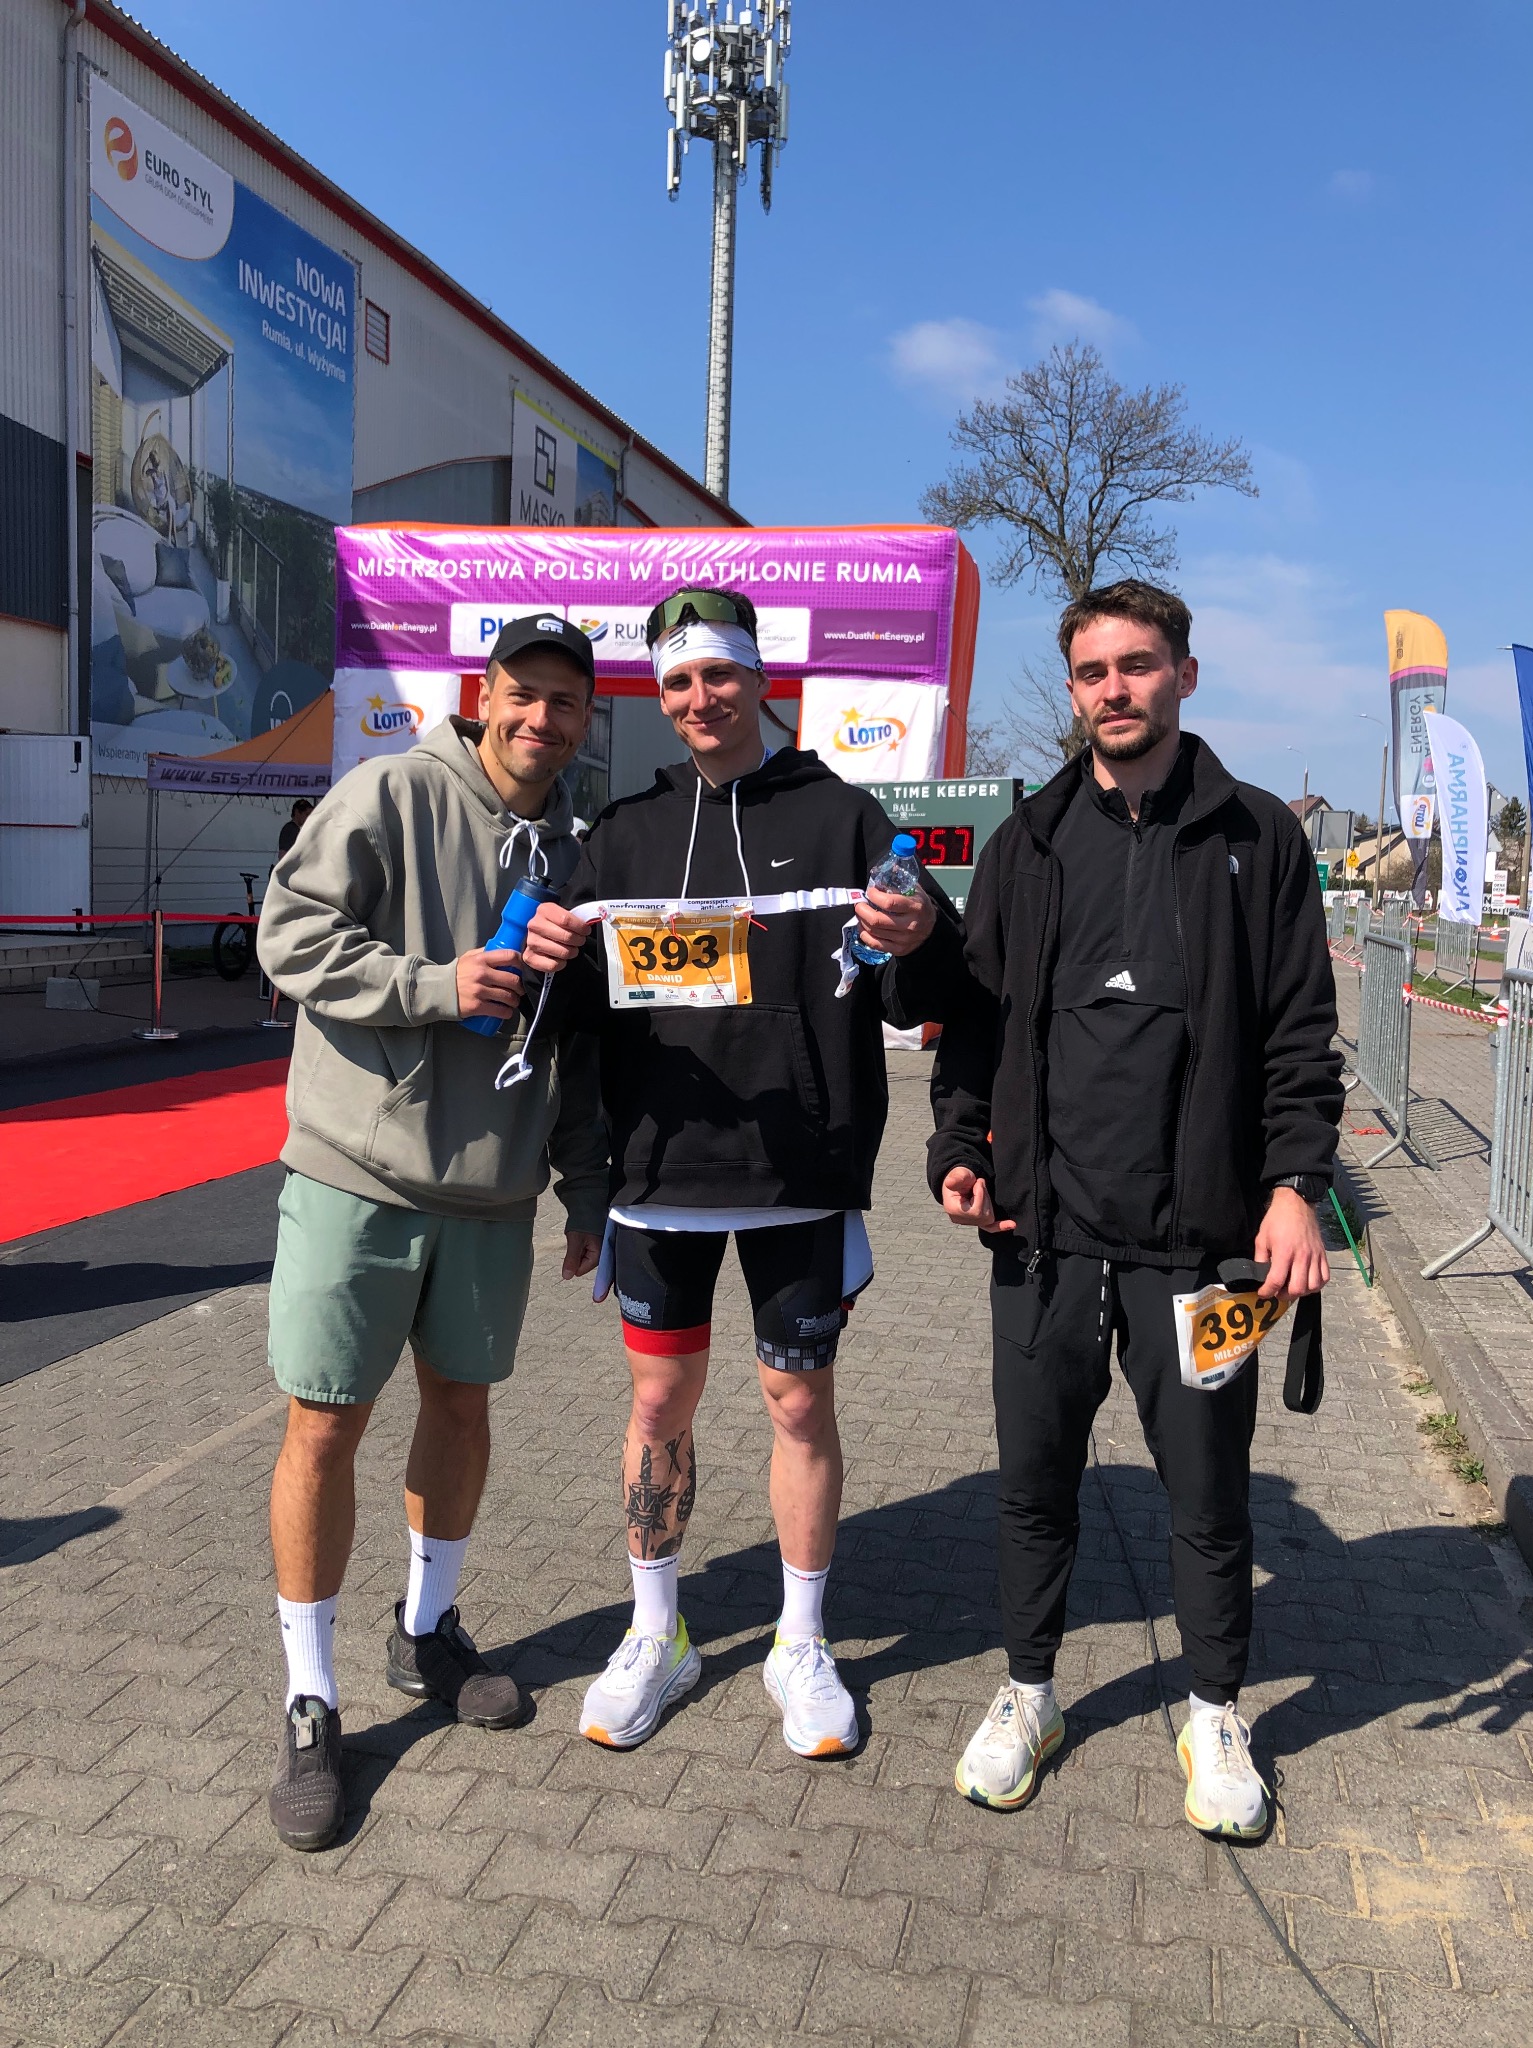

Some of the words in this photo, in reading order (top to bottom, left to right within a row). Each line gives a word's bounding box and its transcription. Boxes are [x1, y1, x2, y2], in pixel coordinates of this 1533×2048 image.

[145, 149, 180, 188] EURO
[184, 177, 214, 214] STYL
[296, 256, 346, 317] NOWA
[239, 258, 347, 354] INWESTYCJA!
[262, 319, 293, 354] Rumia,
[295, 342, 306, 360] ul.
[357, 556, 525, 580] MISTRZOSTWA
[533, 560, 619, 581] POLSKI
[629, 561, 653, 581] W
[661, 560, 826, 582] DUATHLONIE
[836, 562, 922, 583] RUMIA
[350, 621, 437, 634] www.DuathlonEnergy.pl
[823, 631, 925, 643] www.DuathlonEnergy.pl
[373, 710, 412, 730] LOTTO
[848, 724, 892, 745] LOTTO
[98, 744, 141, 763] Wspieramy
[893, 786, 930, 799] TIME
[937, 783, 999, 798] KEEPER
[892, 803, 916, 812] BALL
[628, 934, 719, 971] 393
[646, 973, 683, 983] DAWID
[1105, 981, 1136, 992] adidas
[1200, 1297, 1280, 1350] 392
[1213, 1340, 1255, 1363] MIŁOSZ
